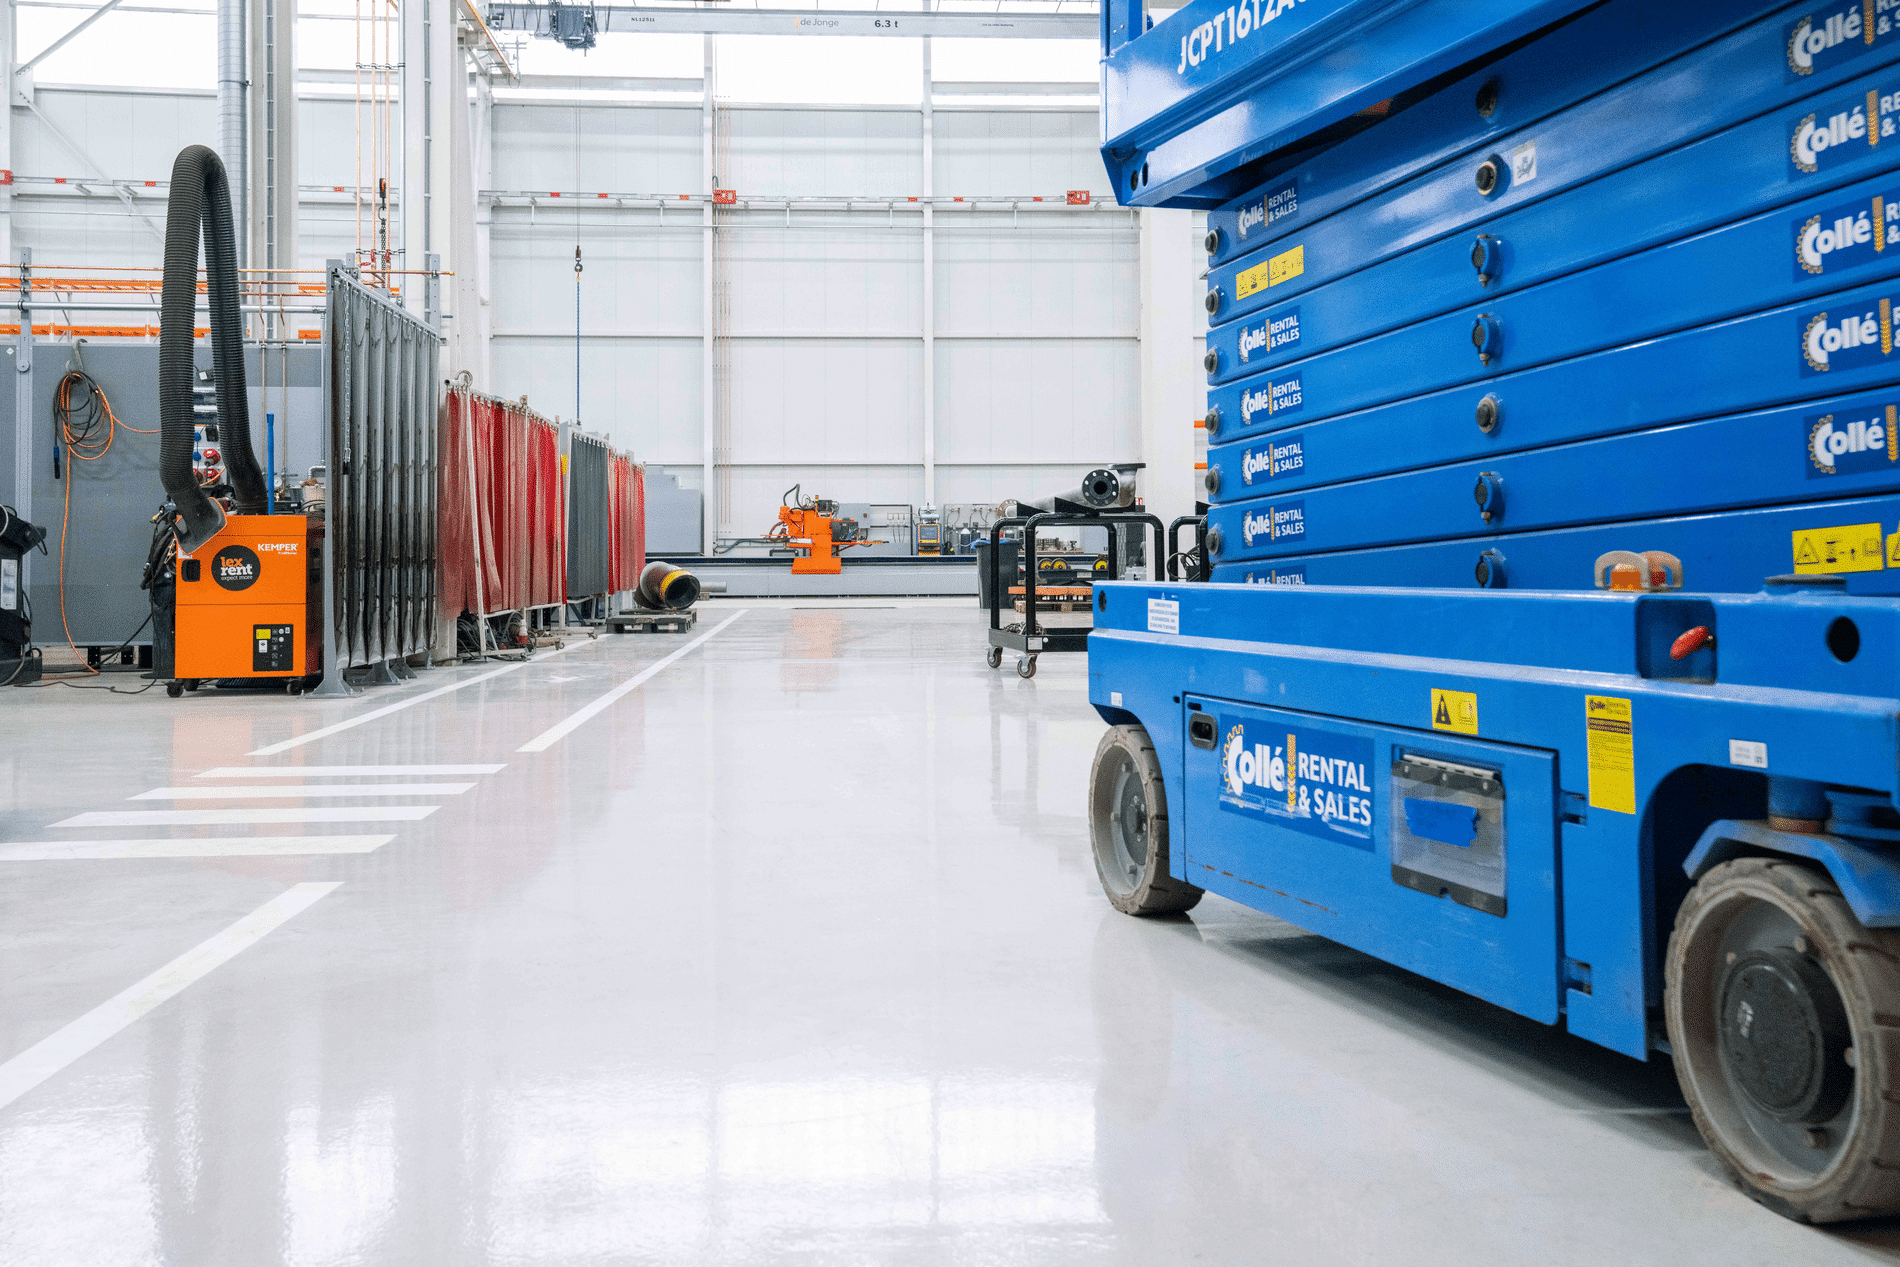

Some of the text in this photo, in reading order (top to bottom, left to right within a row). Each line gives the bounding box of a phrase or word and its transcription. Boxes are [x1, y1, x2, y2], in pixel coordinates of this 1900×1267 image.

[800, 18, 839, 27] de Jonge
[874, 19, 899, 28] 6.3 t
[1876, 15, 1892, 35] &
[1177, 0, 1307, 75] JCPT1612
[1792, 5, 1862, 67] Collé
[1796, 105, 1867, 165] Collé
[1880, 117, 1896, 137] &
[1268, 187, 1296, 209] RENTAL
[1239, 202, 1264, 235] Collé
[1269, 199, 1297, 222] & SALES
[1885, 201, 1900, 222] R
[1801, 210, 1872, 267] Collé
[1270, 315, 1299, 335] RENTAL
[1240, 327, 1266, 358] Collé
[1270, 327, 1300, 348] & SALES
[1807, 311, 1878, 364] Collé
[1272, 379, 1301, 398] RENTAL
[1243, 389, 1268, 420] Collé
[1273, 392, 1302, 411] & SALES
[1273, 442, 1303, 460] RENTAL
[1814, 417, 1885, 467] Collé
[1244, 451, 1269, 480] Collé
[1274, 456, 1303, 473] & SALES
[1274, 508, 1304, 524] RENTAL
[1245, 514, 1270, 542] Collé
[1275, 521, 1304, 537] & SALES
[257, 543, 297, 551] KEMPER
[220, 556, 243, 567] lex
[220, 563, 253, 576] rent
[1276, 573, 1305, 585] RENTAL
[1228, 735, 1285, 796] Collé
[1298, 751, 1371, 793] RENTAL
[1298, 785, 1371, 826] & SALES
